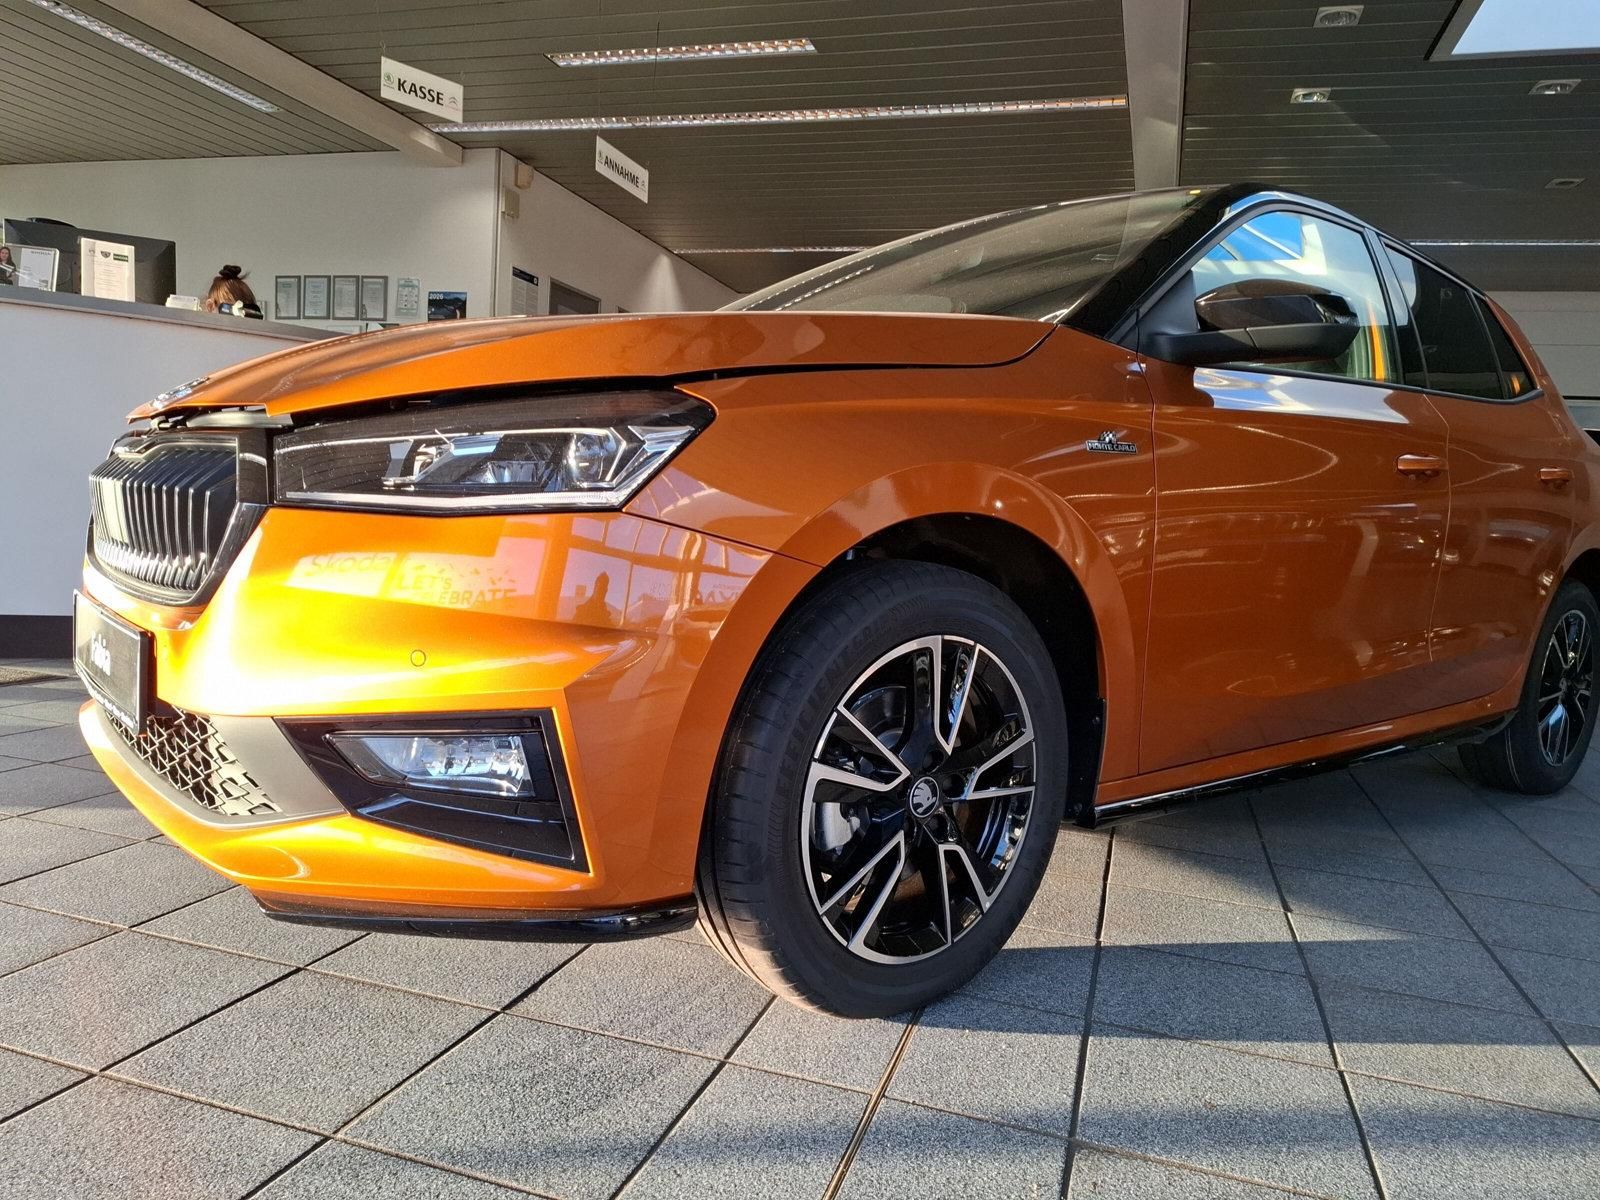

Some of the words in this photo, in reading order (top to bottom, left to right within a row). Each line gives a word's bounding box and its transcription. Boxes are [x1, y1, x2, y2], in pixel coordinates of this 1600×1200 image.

[397, 77, 444, 107] KASSE
[603, 155, 640, 188] ANNAHME
[429, 292, 444, 301] 2026
[1088, 442, 1113, 451] MONTE
[1113, 444, 1136, 453] CARLO
[416, 588, 518, 607] LEBRATE
[91, 630, 111, 676] Fabia
